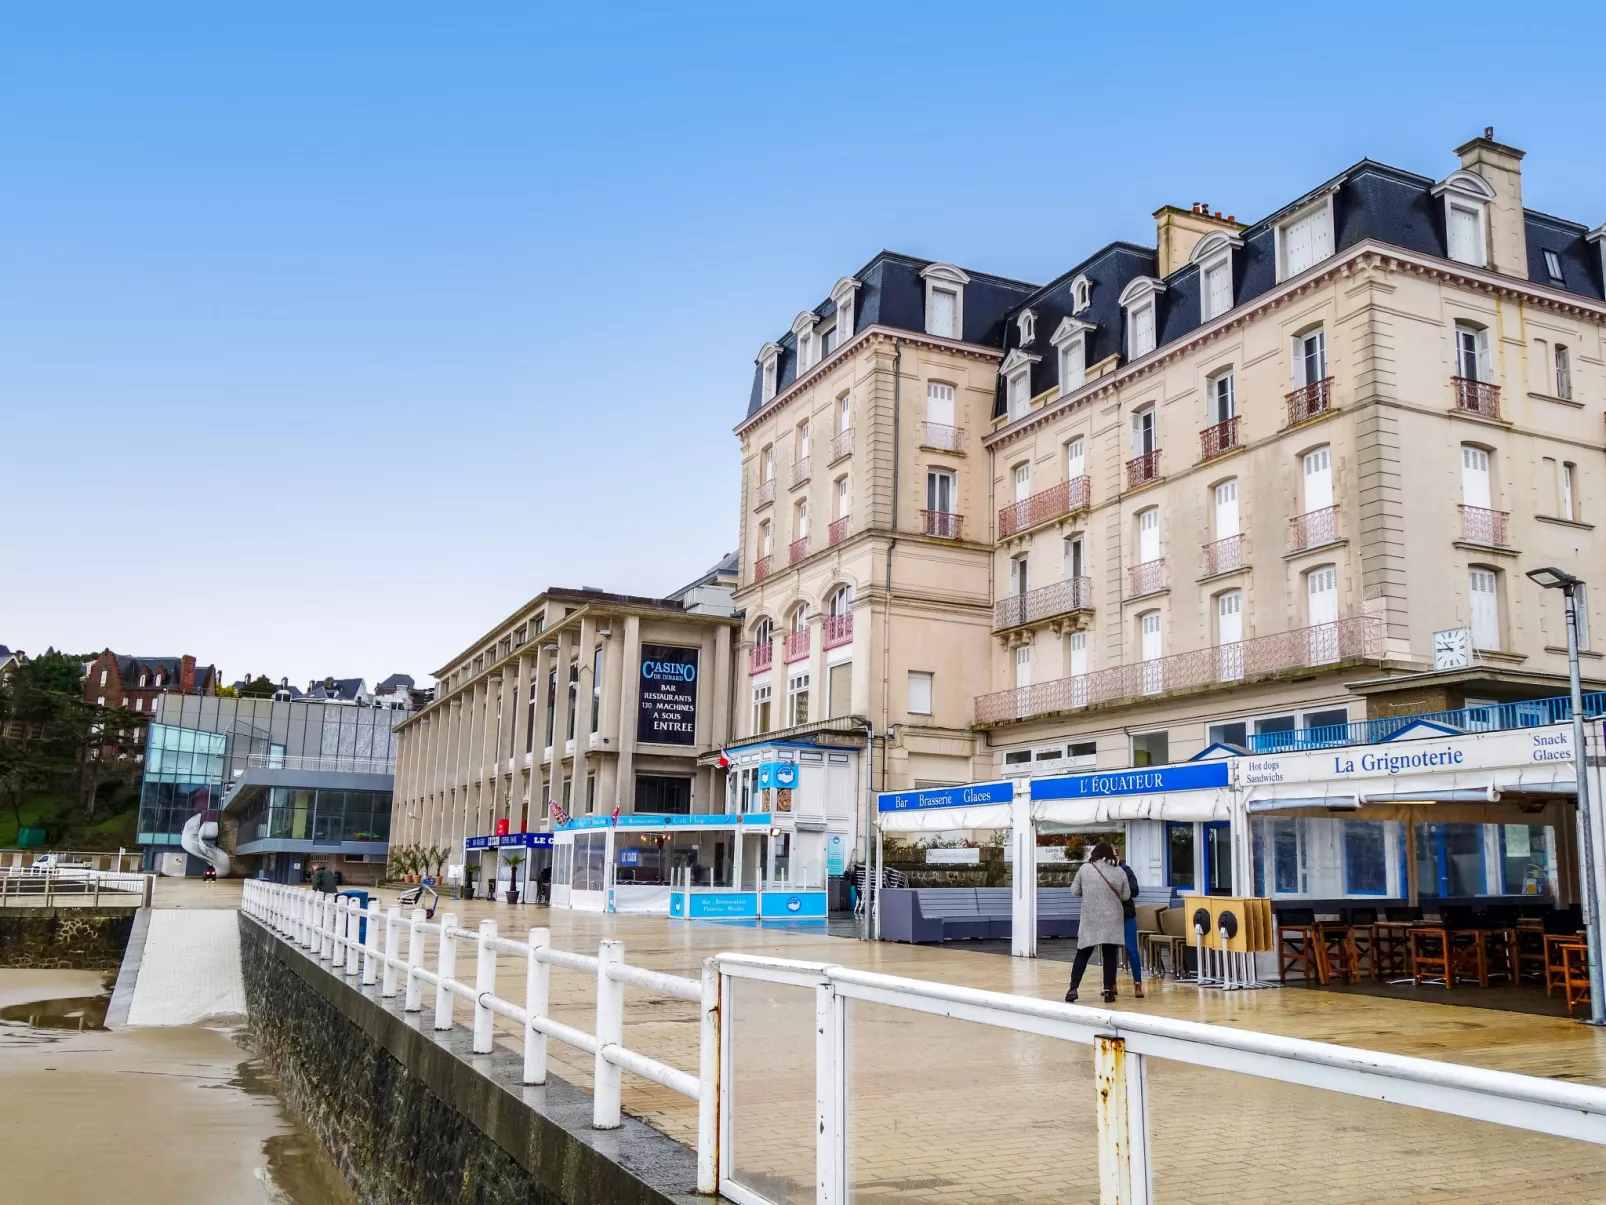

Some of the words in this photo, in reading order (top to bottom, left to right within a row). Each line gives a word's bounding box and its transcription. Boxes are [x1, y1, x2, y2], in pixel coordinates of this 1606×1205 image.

[642, 661, 695, 682] CASINO
[644, 693, 692, 702] RESTAURANTS
[656, 703, 694, 711] MACHINES
[654, 722, 693, 732] ENTREE
[1533, 733, 1568, 746] Snack
[1334, 757, 1354, 774] La
[1362, 747, 1463, 774] Grignoterie
[1533, 749, 1571, 761] Glaces
[1249, 762, 1262, 771] Hot
[1263, 761, 1280, 773] dogs
[1246, 773, 1283, 783] Sandwichs
[895, 796, 908, 808] Bar
[919, 792, 952, 807] Brasserie
[963, 789, 991, 802] Glaces
